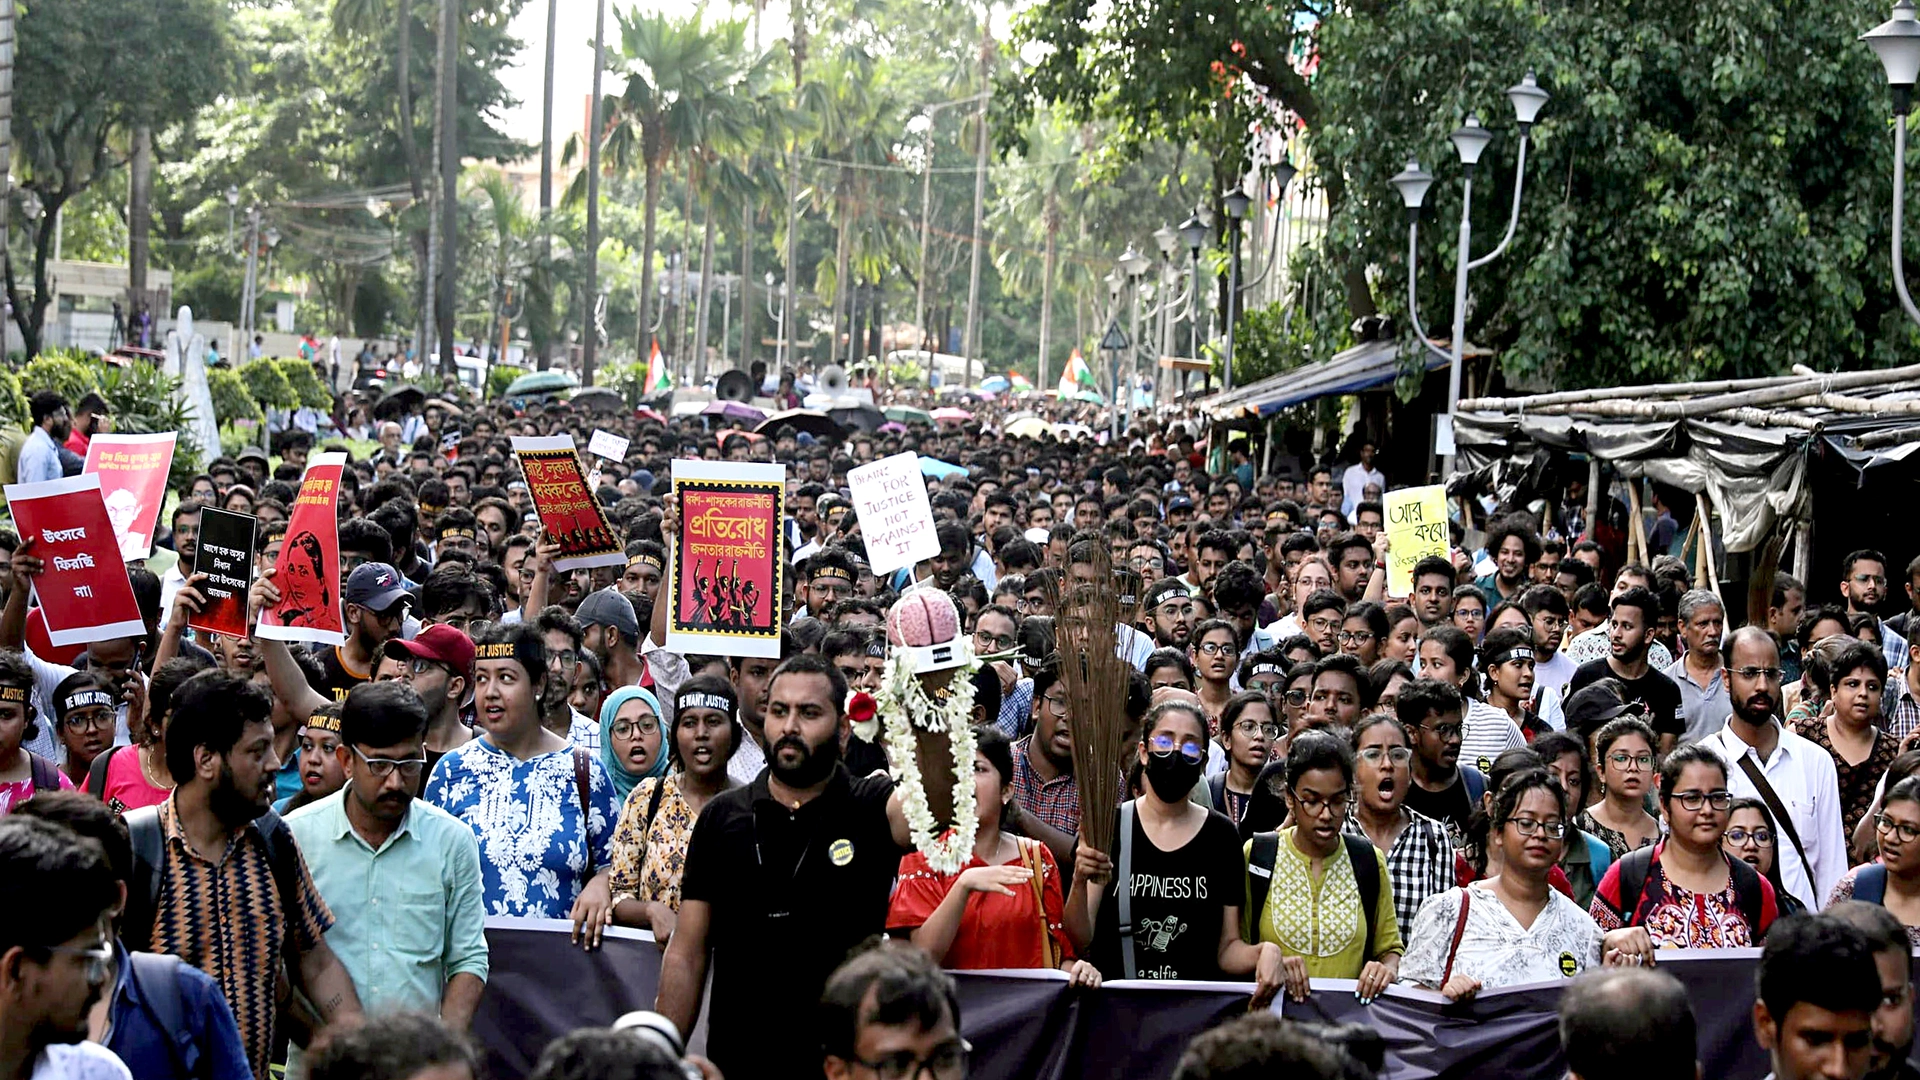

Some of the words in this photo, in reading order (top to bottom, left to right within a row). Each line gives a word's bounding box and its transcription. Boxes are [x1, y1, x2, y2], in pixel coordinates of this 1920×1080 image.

[525, 456, 544, 480] রাষ্ট্র
[544, 460, 577, 479] লুকায়
[534, 478, 582, 499] ধর্ষককে
[706, 495, 737, 508] শাসকের
[738, 494, 772, 509] রাজনীতি
[864, 491, 916, 516] JUSTICE
[1389, 501, 1423, 524] আর
[689, 507, 767, 540] প্রতিরোধ
[1415, 521, 1447, 542] কবে?
[42, 527, 86, 543] উৎসবে
[203, 543, 218, 554] আগে
[690, 543, 724, 557] জনতার
[725, 541, 766, 558] রাজনীতি
[895, 541, 911, 555] IT
[53, 553, 95, 572] ফিরছি
[209, 573, 220, 583] হবে
[220, 573, 246, 588] উৎসবের
[487, 643, 514, 657] JUSTICE
[1, 687, 24, 701] JUSTICE
[65, 696, 74, 710] WE
[73, 692, 93, 707] WANT
[94, 691, 112, 706] JUSTICE
[679, 695, 686, 709] WE
[686, 693, 705, 706] WANT
[706, 694, 730, 711] JUSTICE
[327, 717, 341, 731] JUS
[1195, 876, 1208, 899] IS
[1138, 969, 1145, 978] a
